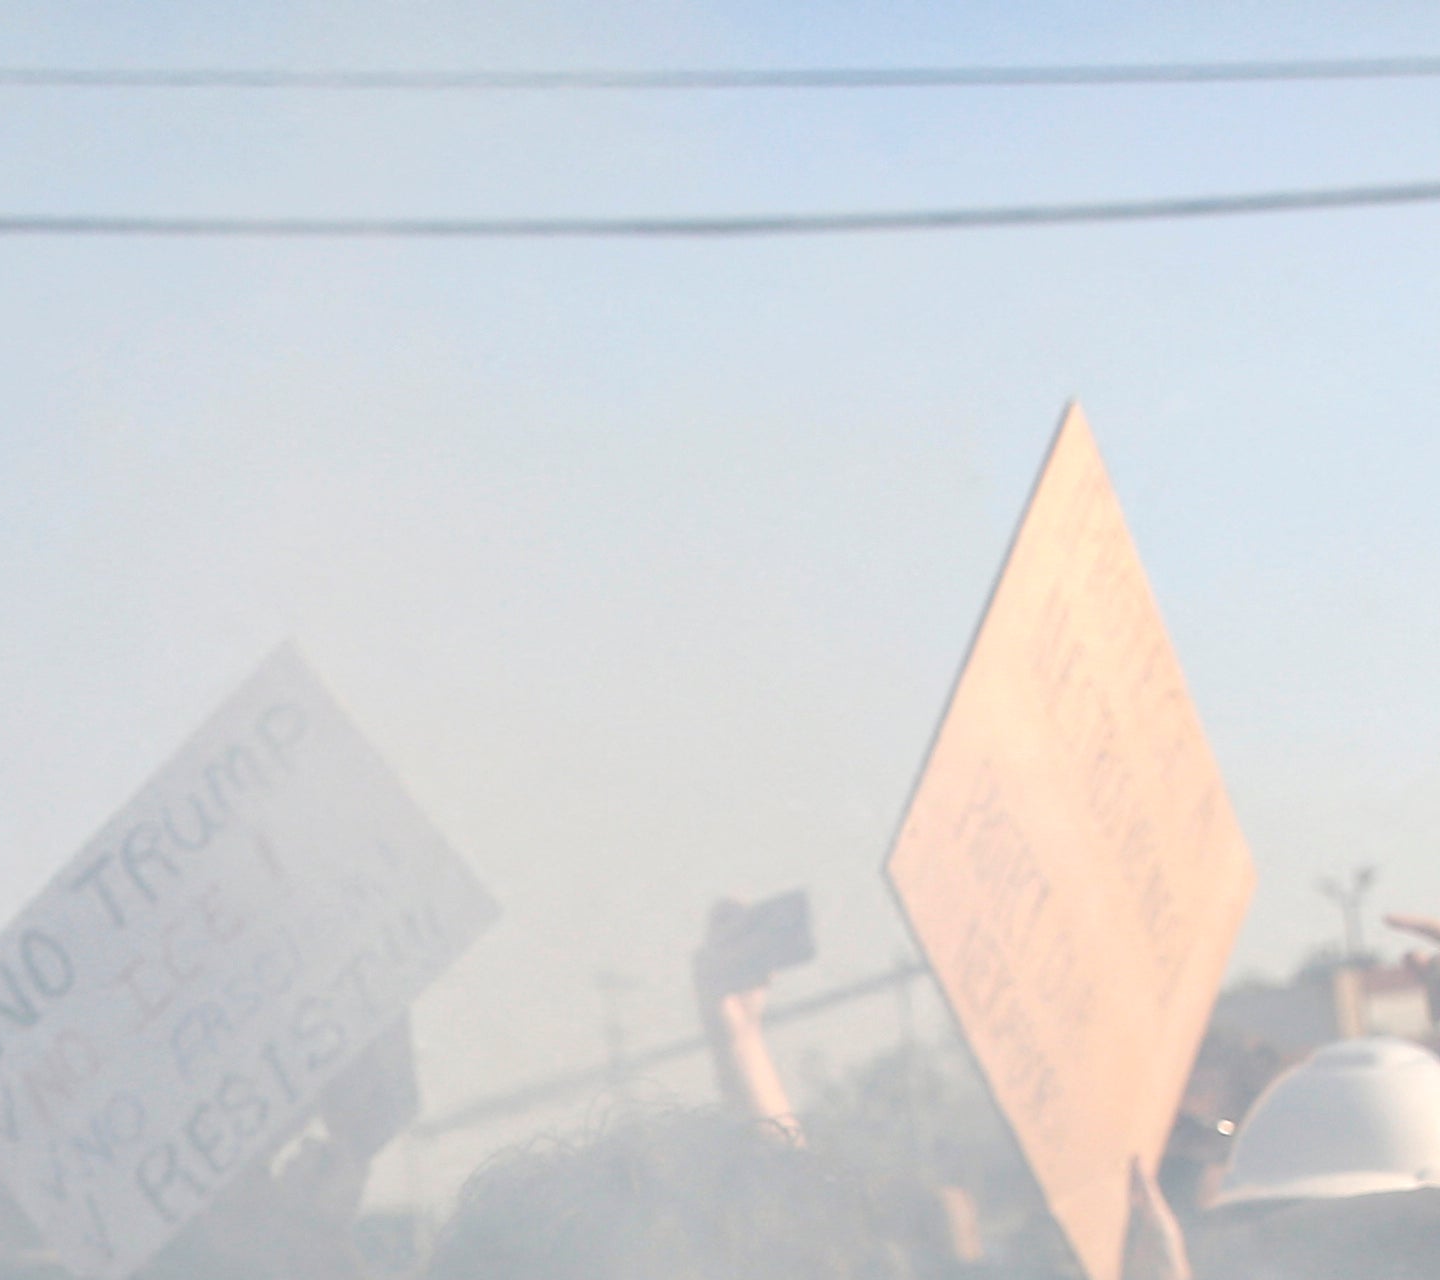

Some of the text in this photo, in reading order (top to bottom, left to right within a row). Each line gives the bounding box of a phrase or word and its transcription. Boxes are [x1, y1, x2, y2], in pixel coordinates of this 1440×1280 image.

[71, 702, 308, 929] TRUMP
[21, 1028, 103, 1122] NO
[72, 1087, 149, 1170] NO
